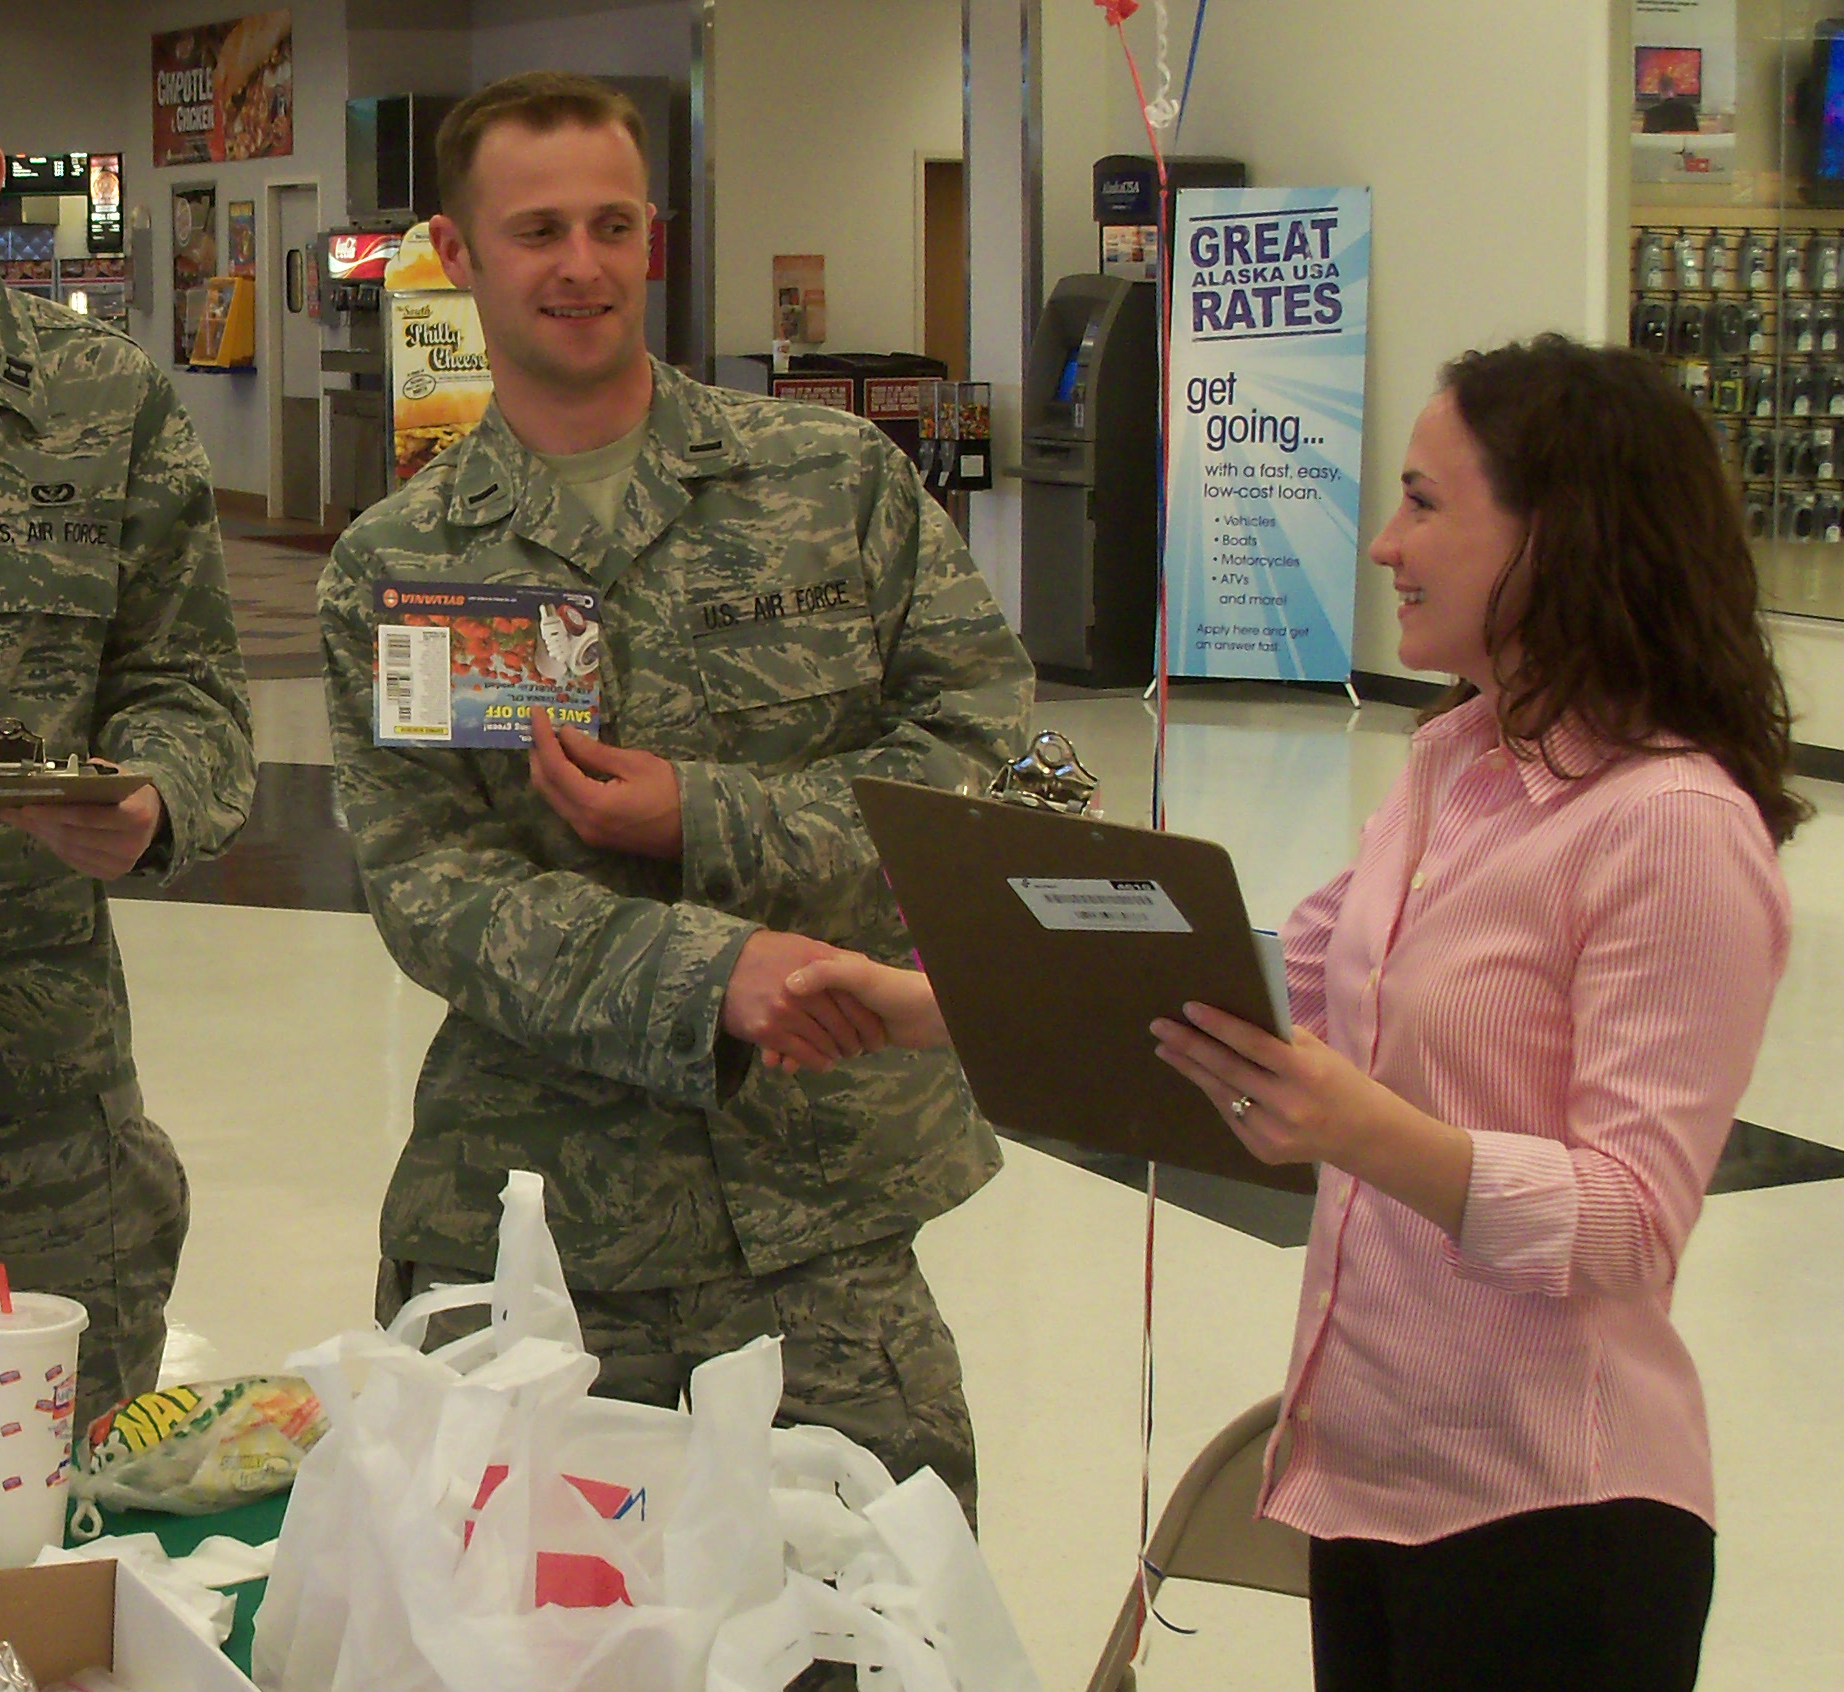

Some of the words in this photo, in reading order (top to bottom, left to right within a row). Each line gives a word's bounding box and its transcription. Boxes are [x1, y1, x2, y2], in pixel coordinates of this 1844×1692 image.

[1189, 217, 1338, 269] GREAT
[1191, 266, 1286, 288] ALASKA
[1292, 262, 1341, 281] USA
[1191, 282, 1343, 333] RATES
[406, 322, 463, 350] Philly
[1186, 371, 1238, 414] get
[1206, 408, 1325, 454] going...
[1204, 462, 1239, 478] with
[1242, 466, 1256, 478] a
[1259, 463, 1294, 480] fast,
[1297, 466, 1342, 482] easy,
[1203, 483, 1275, 499] low-cost
[1278, 485, 1322, 500] loan.
[1223, 515, 1277, 527] Vehicles
[27, 521, 54, 543] AIR
[64, 521, 109, 545] FORCE
[1222, 534, 1258, 546] Boats
[1221, 553, 1301, 568] Motorcycles
[1220, 573, 1250, 585] ATVs
[400, 593, 466, 607] SYLVANIA
[703, 603, 740, 630] U.S.
[754, 593, 786, 622] AIR
[794, 579, 850, 614] FORCE
[1219, 593, 1246, 605] and
[1196, 623, 1231, 636] Apply
[1232, 624, 1260, 636] here
[1261, 626, 1288, 637] and
[1289, 626, 1310, 640] get
[1214, 640, 1256, 651] answer
[484, 705, 514, 719] OFF
[558, 708, 592, 724] SAVE
